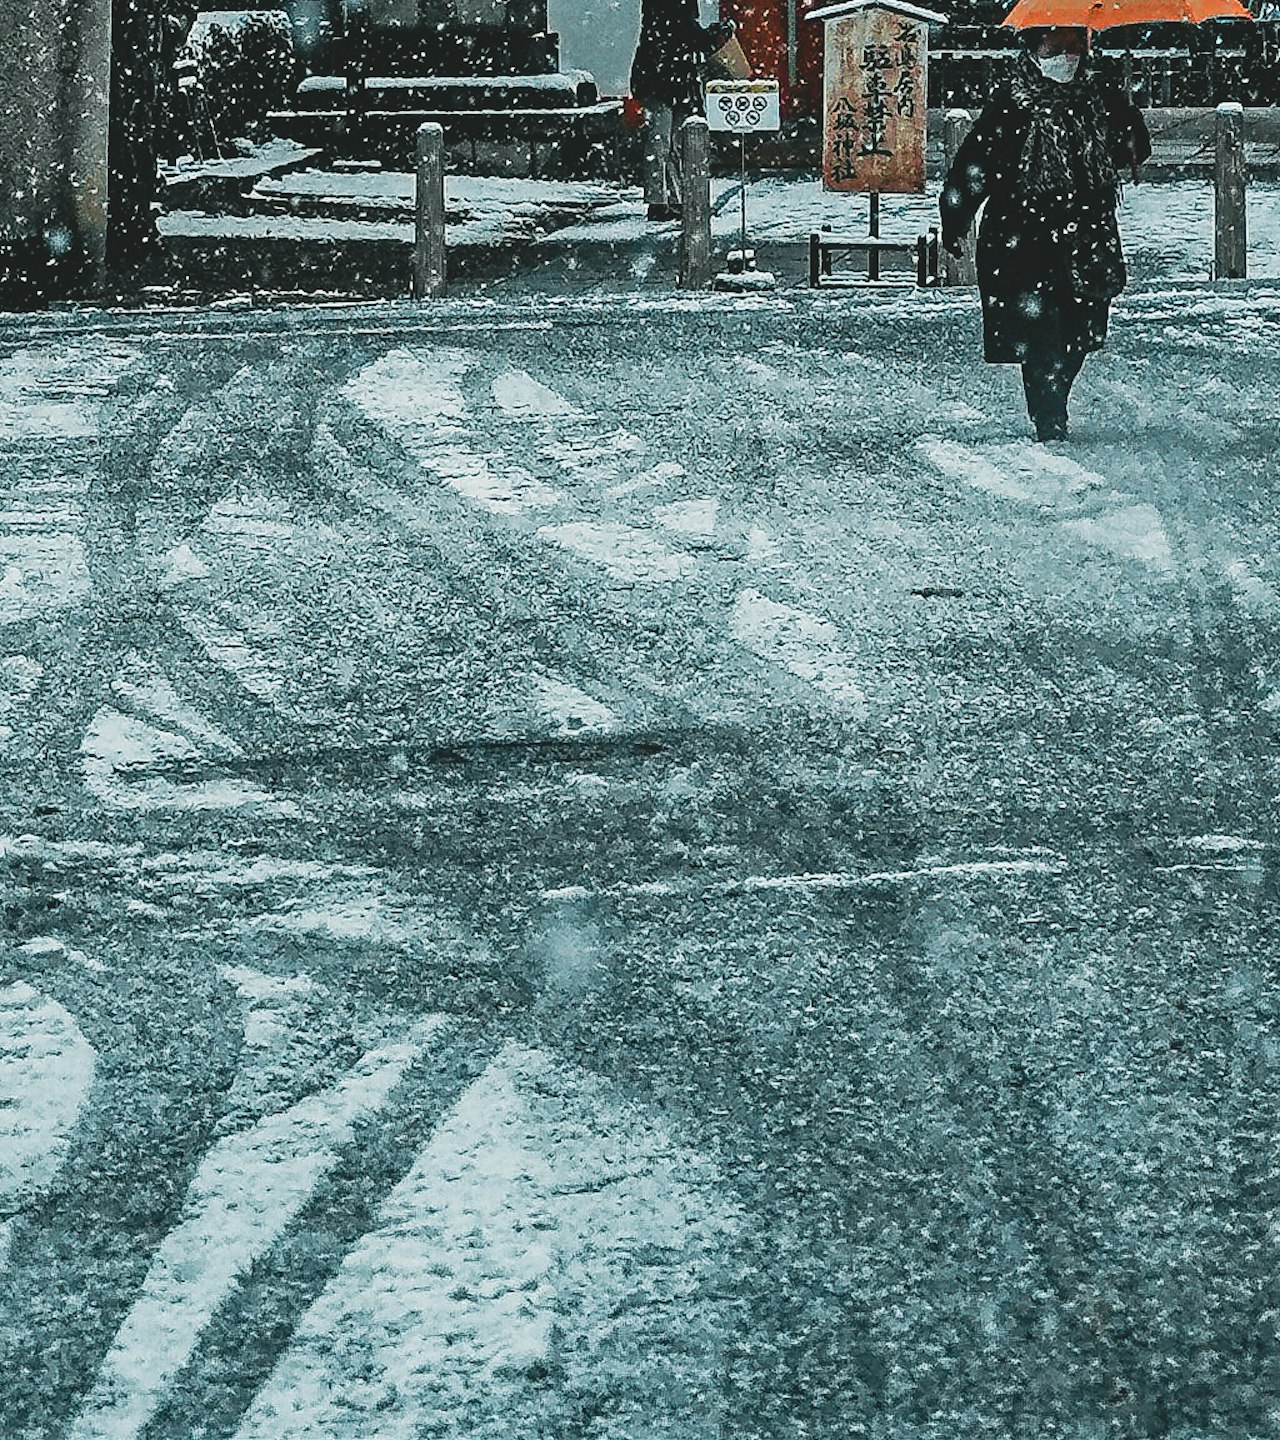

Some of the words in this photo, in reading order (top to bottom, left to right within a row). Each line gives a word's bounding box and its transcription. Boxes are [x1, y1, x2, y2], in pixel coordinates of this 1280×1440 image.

[831, 97, 858, 183] 八坂神社
[856, 44, 893, 157] 駐車禁止
